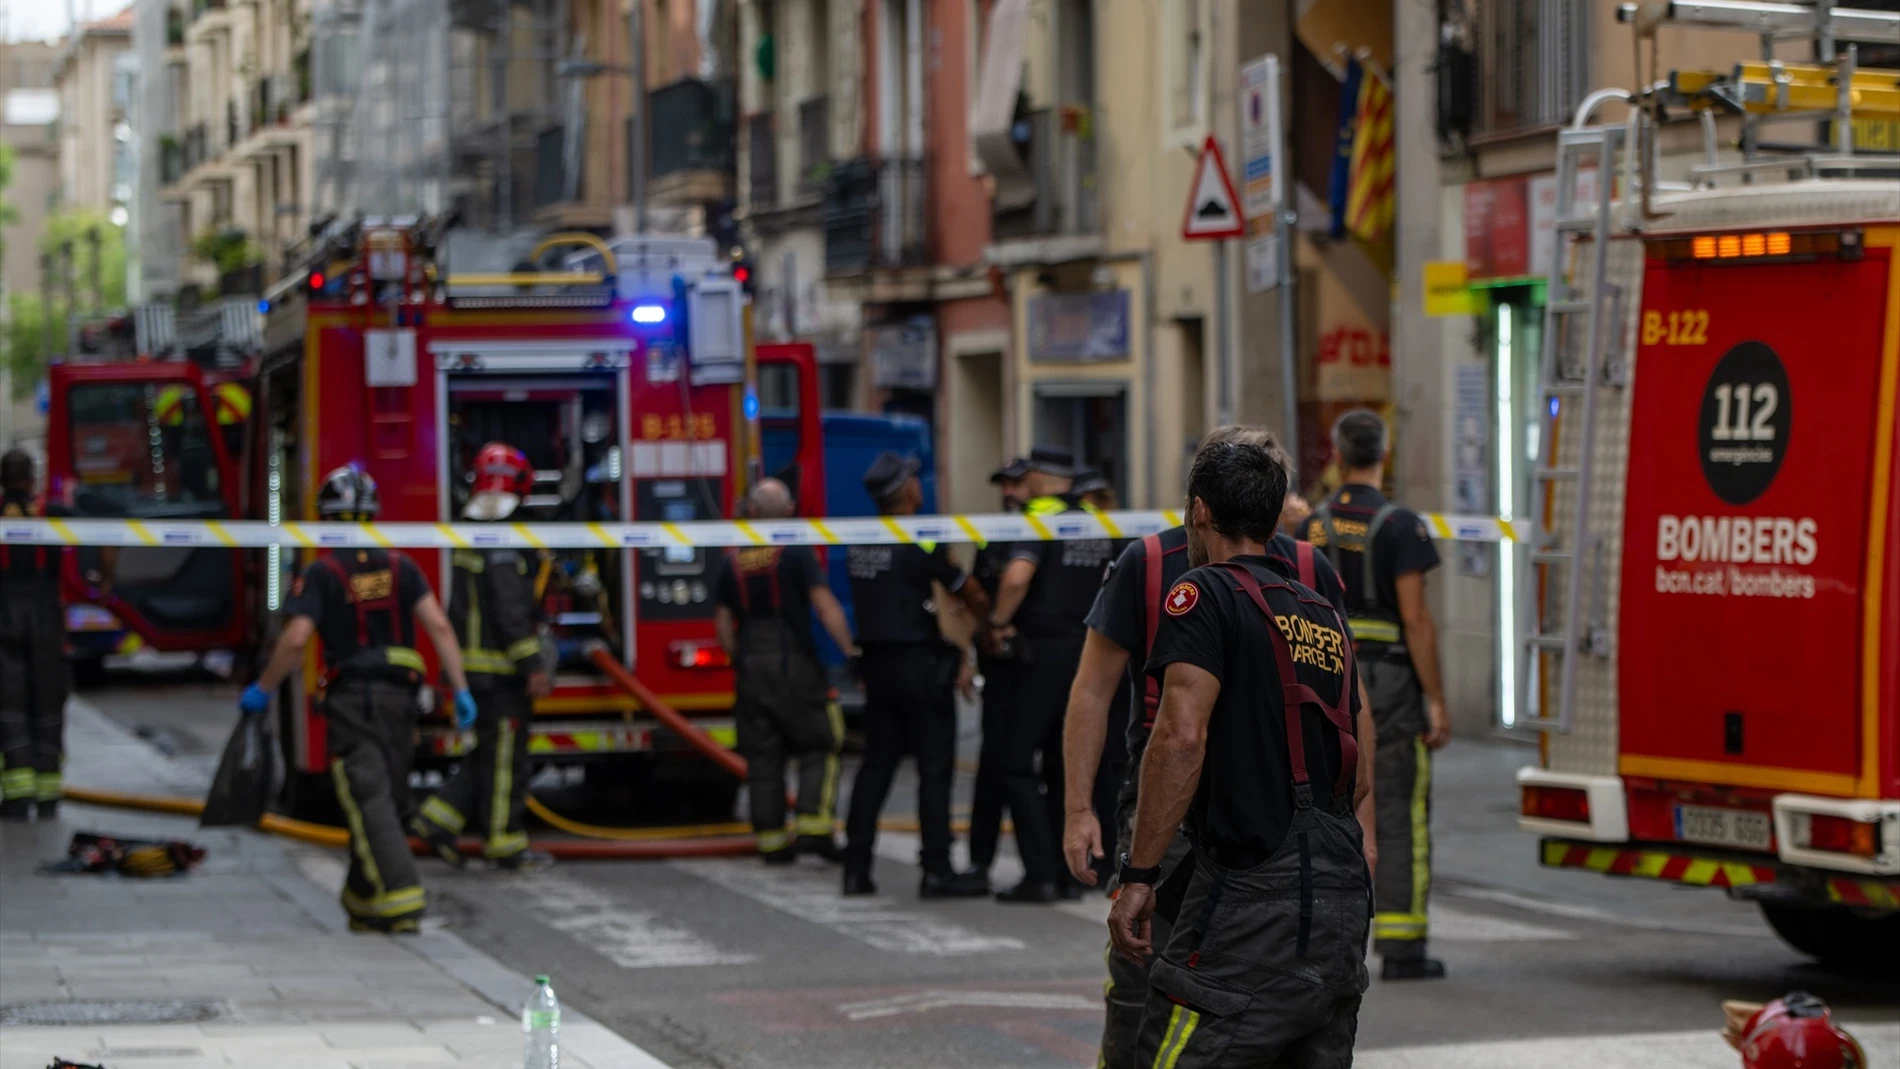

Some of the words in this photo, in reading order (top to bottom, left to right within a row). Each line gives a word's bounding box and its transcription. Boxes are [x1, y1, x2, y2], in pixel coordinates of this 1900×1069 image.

[1642, 310, 1709, 345] B-122
[1711, 381, 1778, 440] 112
[1656, 514, 1818, 565] BOMBERS
[1655, 564, 1816, 599] bcn.cat/bombers
[1274, 614, 1345, 657] BOMBER
